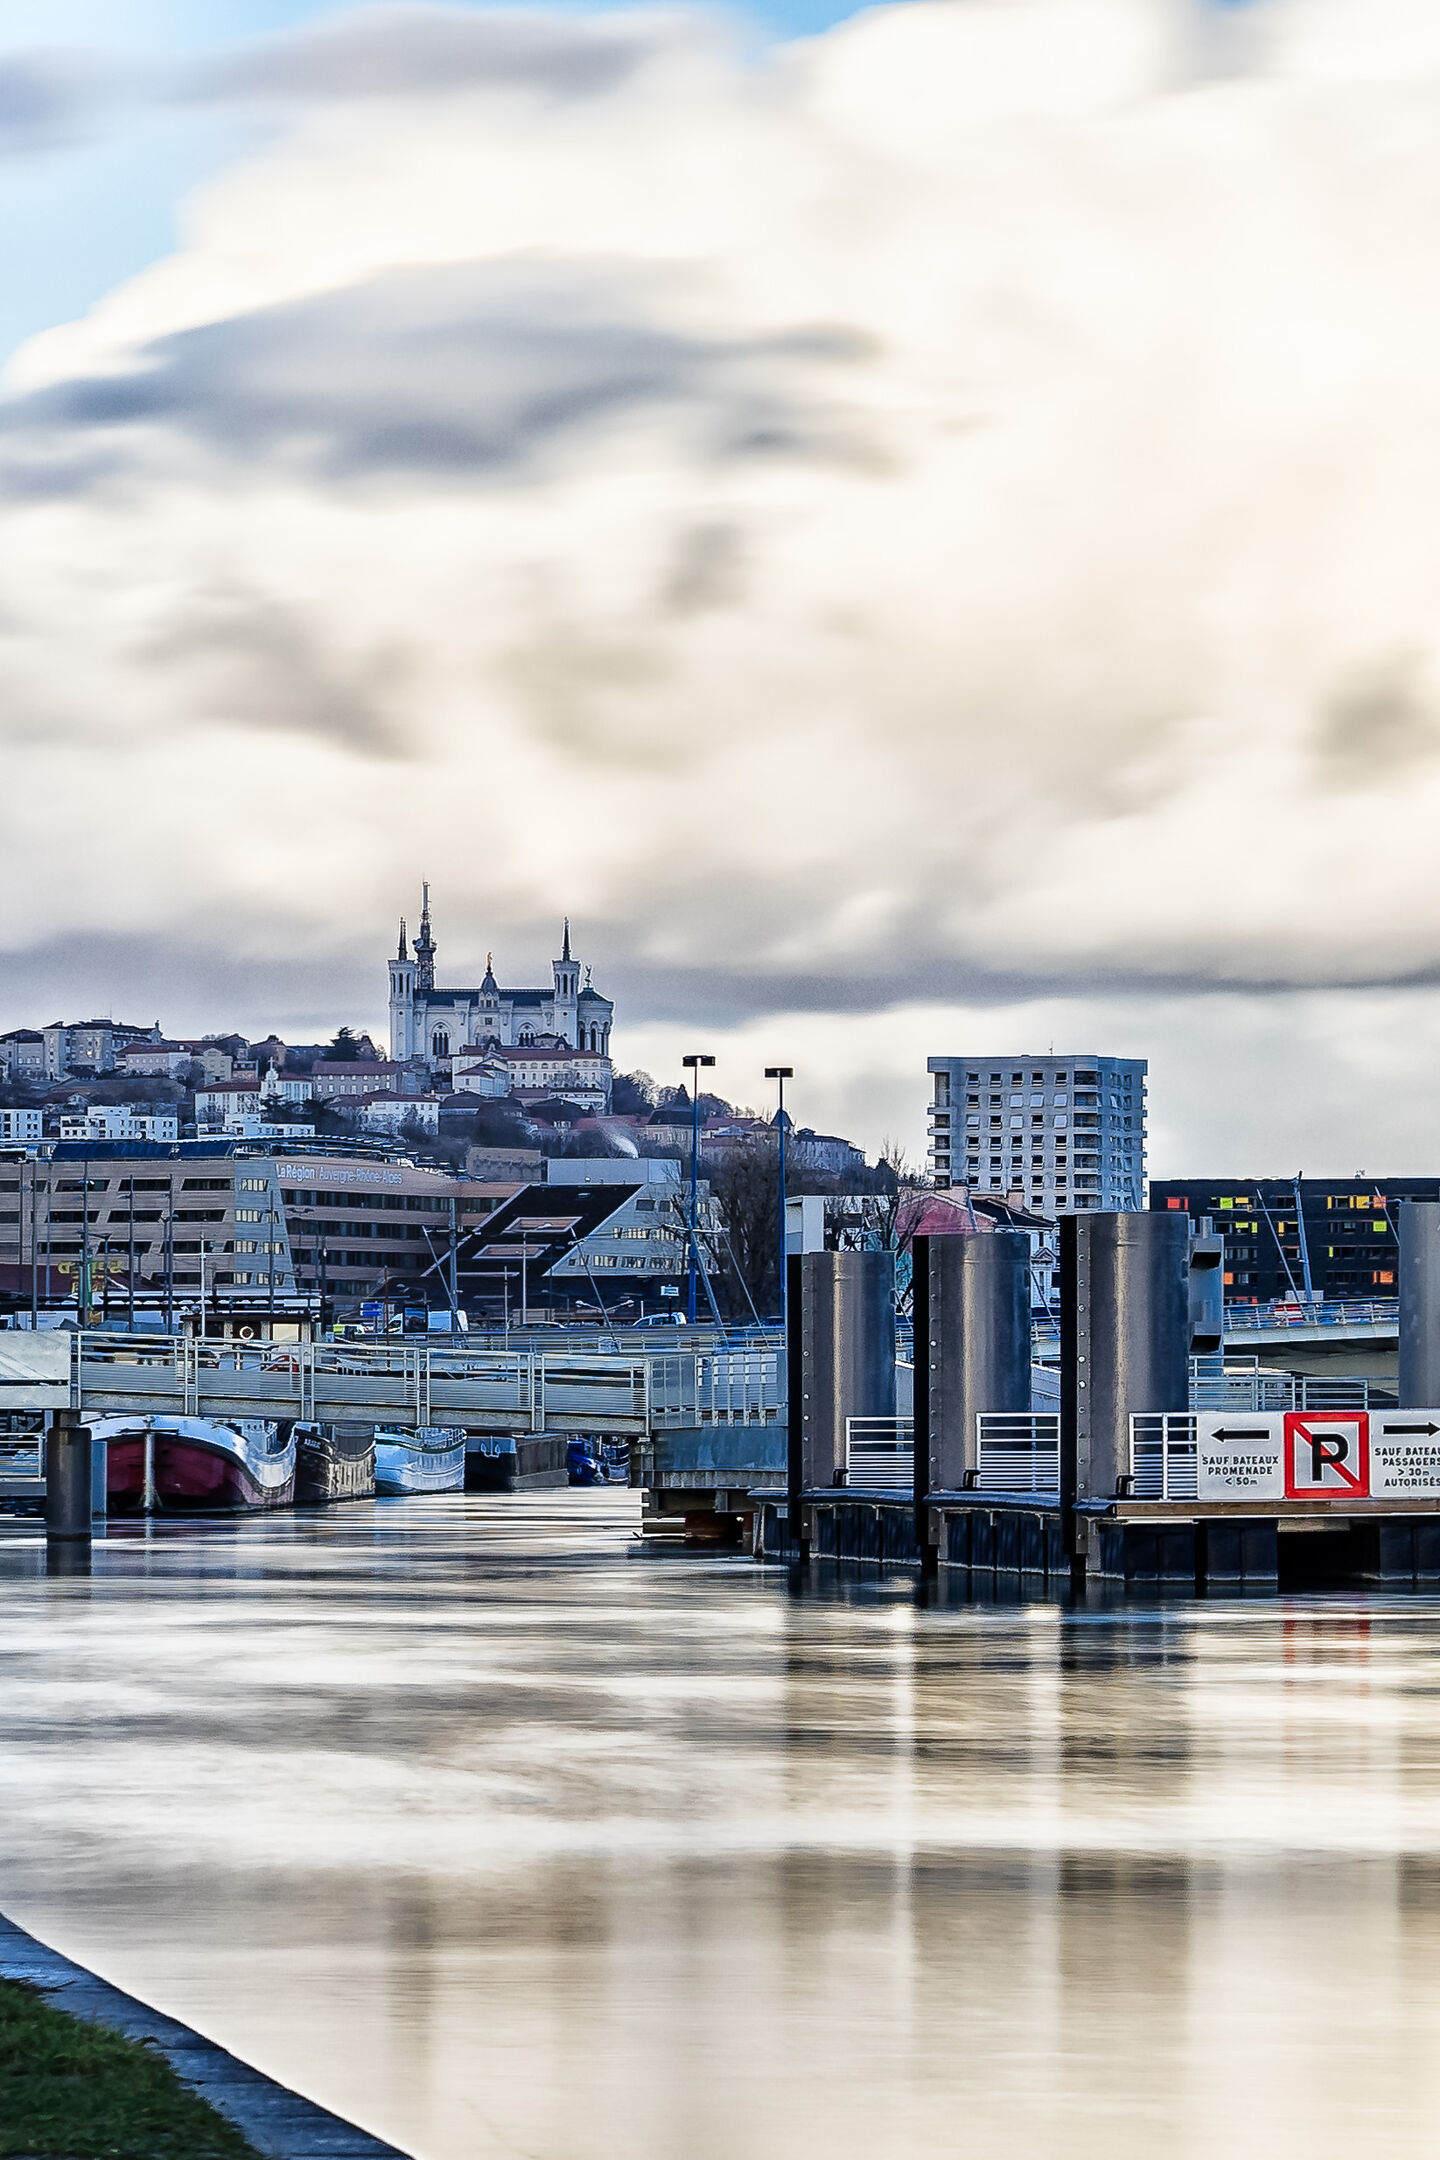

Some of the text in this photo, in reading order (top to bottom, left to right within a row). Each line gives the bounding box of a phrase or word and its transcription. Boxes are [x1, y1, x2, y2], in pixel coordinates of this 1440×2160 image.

[286, 1164, 315, 1182] Région
[1375, 1447, 1402, 1456] SAUF
[1202, 1455, 1279, 1465] SAUF BATEAUX
[1312, 1433, 1348, 1482] P
[1208, 1466, 1272, 1475] PROMENADE
[1236, 1477, 1258, 1486] 50m
